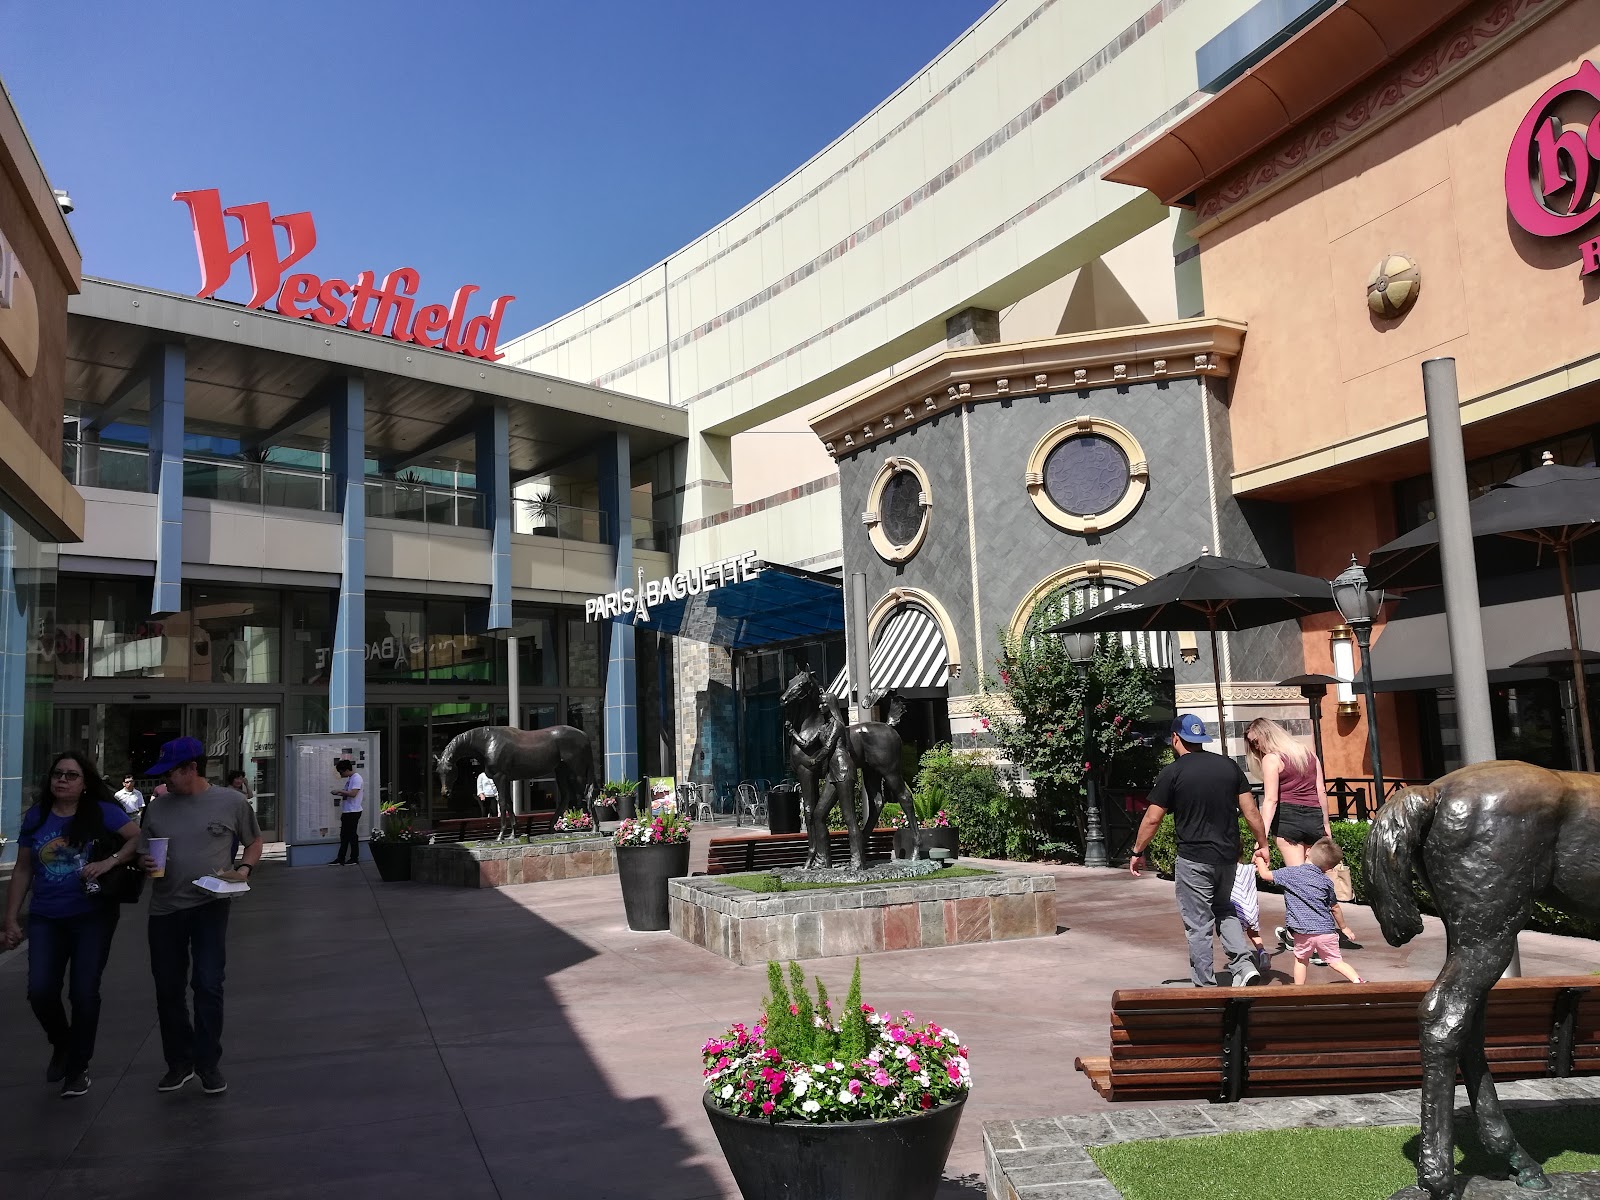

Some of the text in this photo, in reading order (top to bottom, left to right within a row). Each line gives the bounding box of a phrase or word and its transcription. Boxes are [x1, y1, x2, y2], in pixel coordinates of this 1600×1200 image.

[172, 188, 516, 361] Westfield
[586, 550, 760, 623] PARIS BAGUETTE
